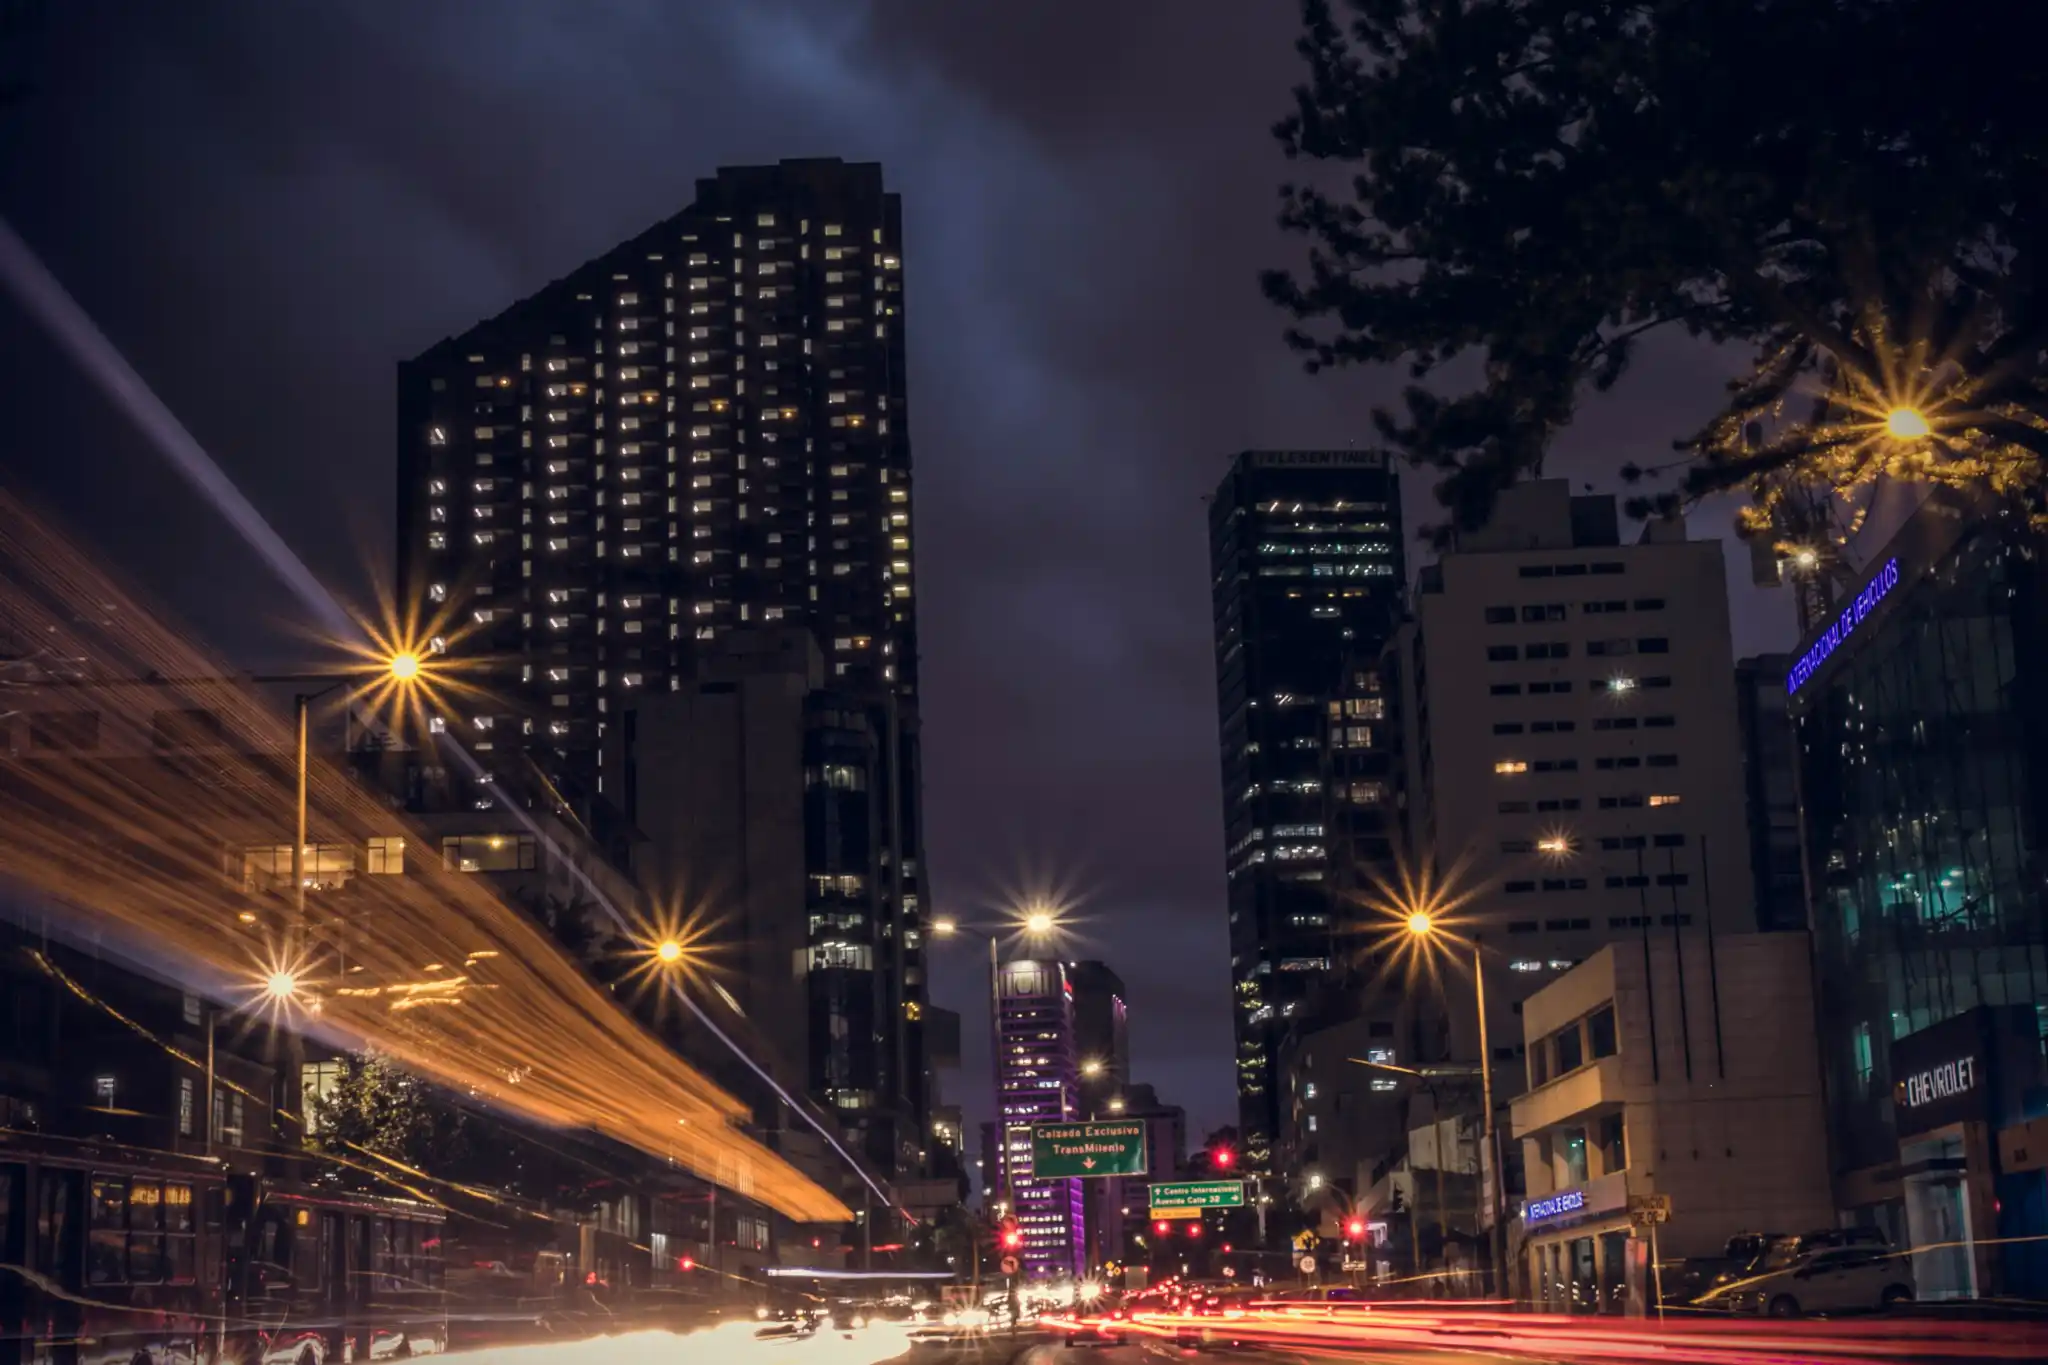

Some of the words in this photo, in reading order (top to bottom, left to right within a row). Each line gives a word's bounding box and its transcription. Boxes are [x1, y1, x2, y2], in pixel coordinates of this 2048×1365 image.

[1787, 622, 1841, 696] INTERNACIONAL
[1840, 607, 1853, 638] DE
[1852, 557, 1899, 625] VEHICULOS
[1908, 1055, 1974, 1107] CHEVROLET
[1037, 1128, 1081, 1139] Calzada
[1085, 1126, 1139, 1137] Exclusiva
[1053, 1142, 1125, 1154] TransMilenio
[1163, 1187, 1189, 1195] Centro
[1187, 1196, 1207, 1204] Calle
